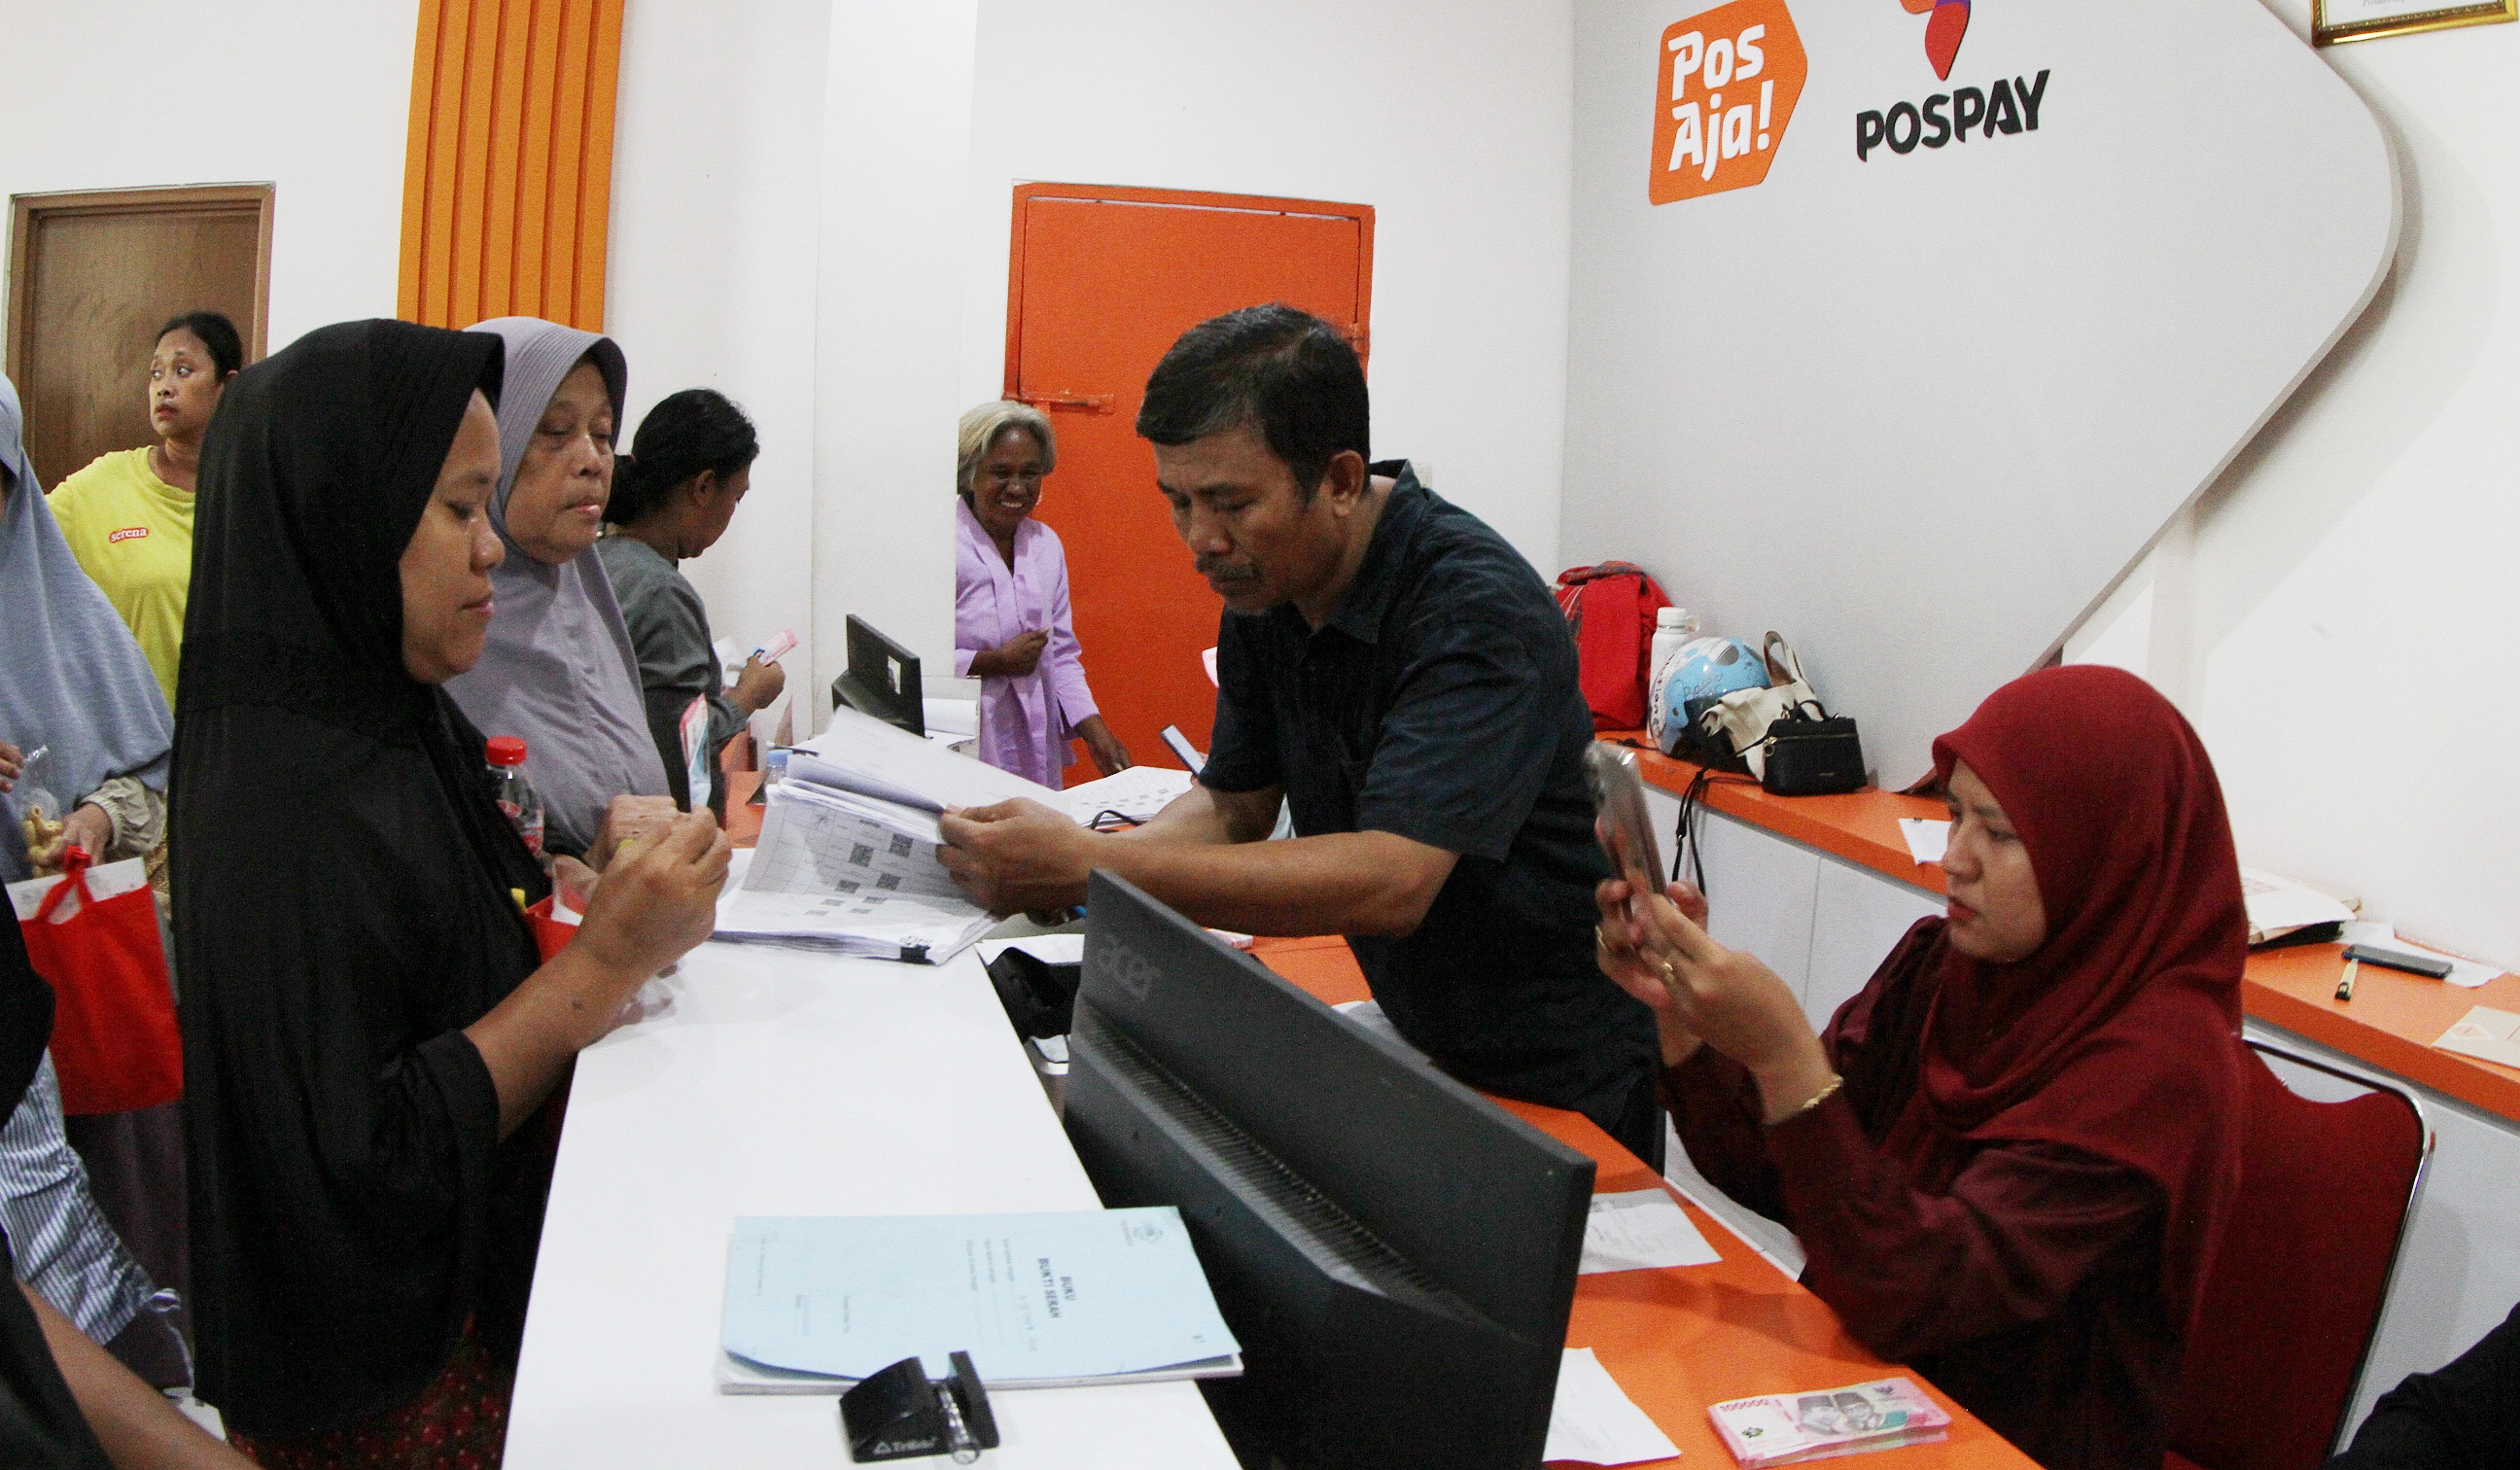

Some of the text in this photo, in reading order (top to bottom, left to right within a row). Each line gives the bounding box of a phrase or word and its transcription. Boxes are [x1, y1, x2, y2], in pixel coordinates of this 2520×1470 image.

[1667, 23, 1766, 101] Pos
[1667, 80, 1774, 182] Aja!
[1856, 69, 2050, 162] POSPAY
[110, 528, 147, 542] serena
[1037, 1257, 1054, 1288] BUKTI
[1060, 1276, 1076, 1302] BUKU
